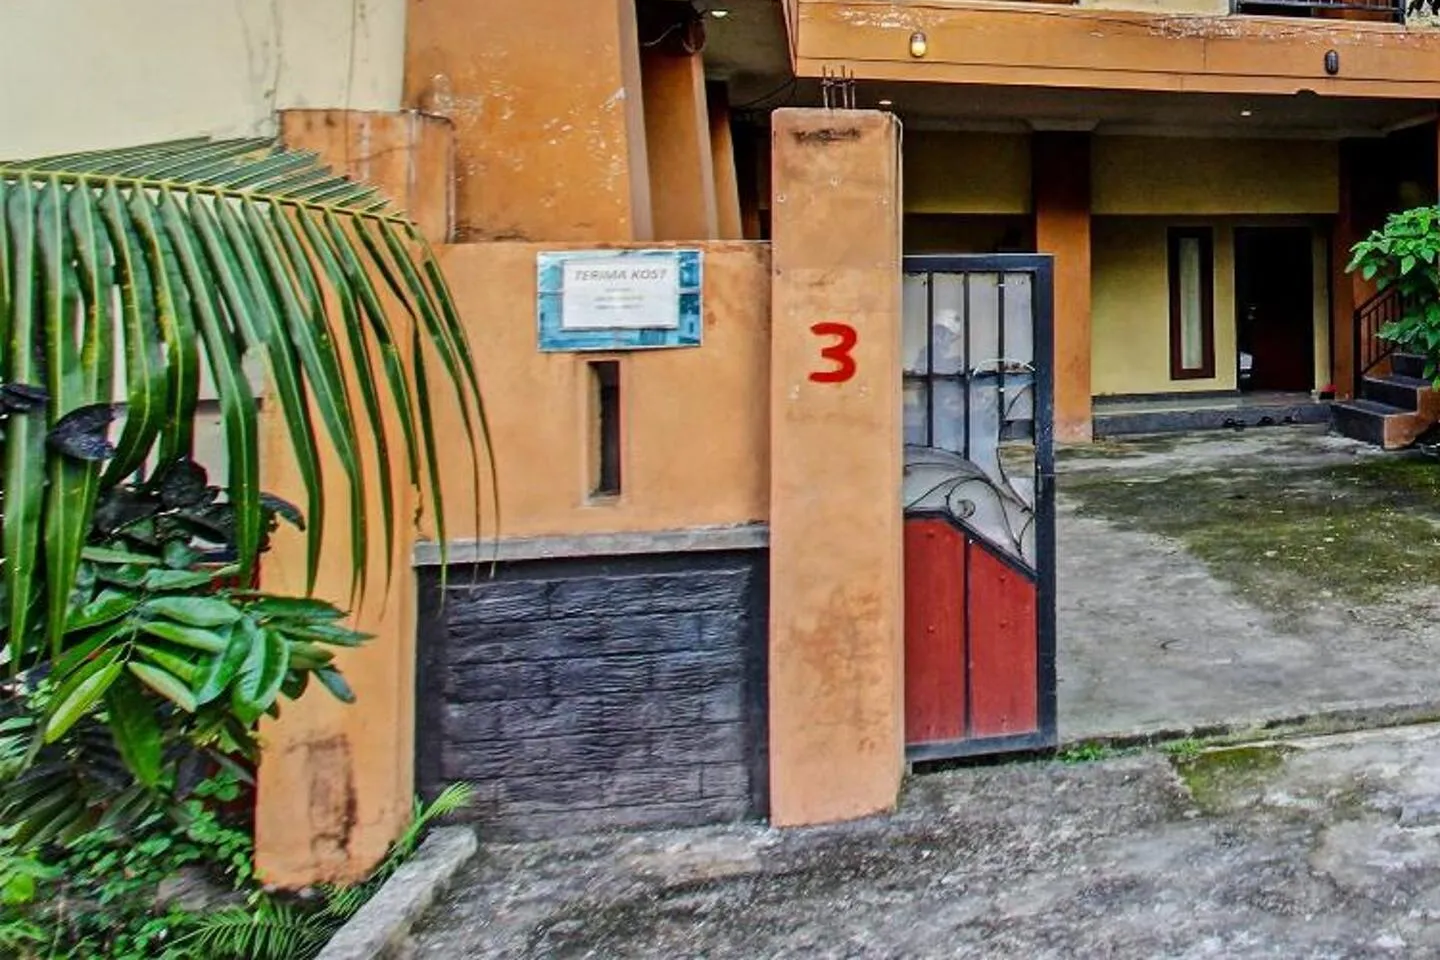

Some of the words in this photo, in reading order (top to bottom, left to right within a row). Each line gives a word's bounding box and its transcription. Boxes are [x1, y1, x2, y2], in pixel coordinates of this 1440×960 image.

[574, 269, 628, 281] TERIMA
[630, 268, 669, 281] KOST
[807, 321, 858, 384] 3
